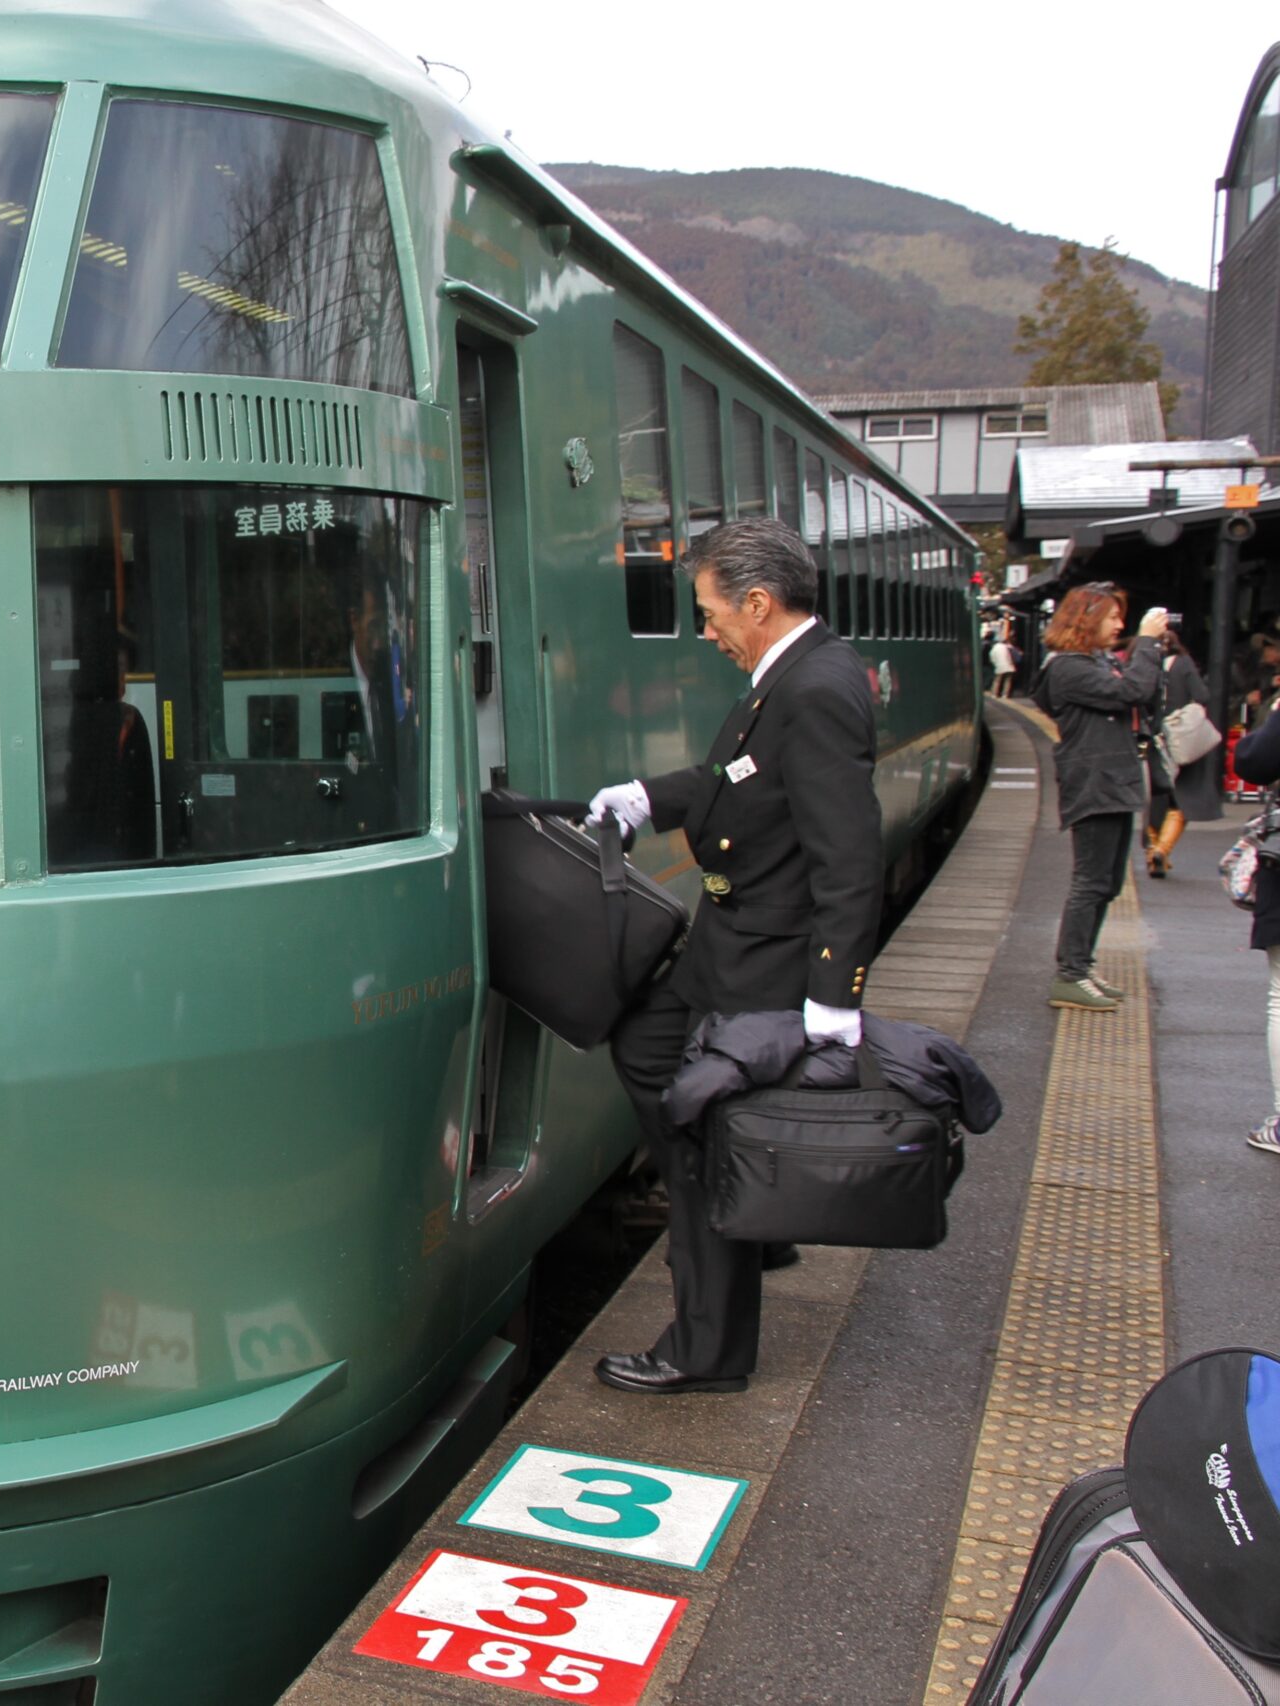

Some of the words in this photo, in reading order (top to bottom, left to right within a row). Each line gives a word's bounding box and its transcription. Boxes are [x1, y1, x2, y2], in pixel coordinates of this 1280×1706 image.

[66, 1359, 140, 1384] COMPANY
[526, 1467, 673, 1540] 3
[475, 1575, 589, 1638] 3
[415, 1627, 605, 1695] 185
